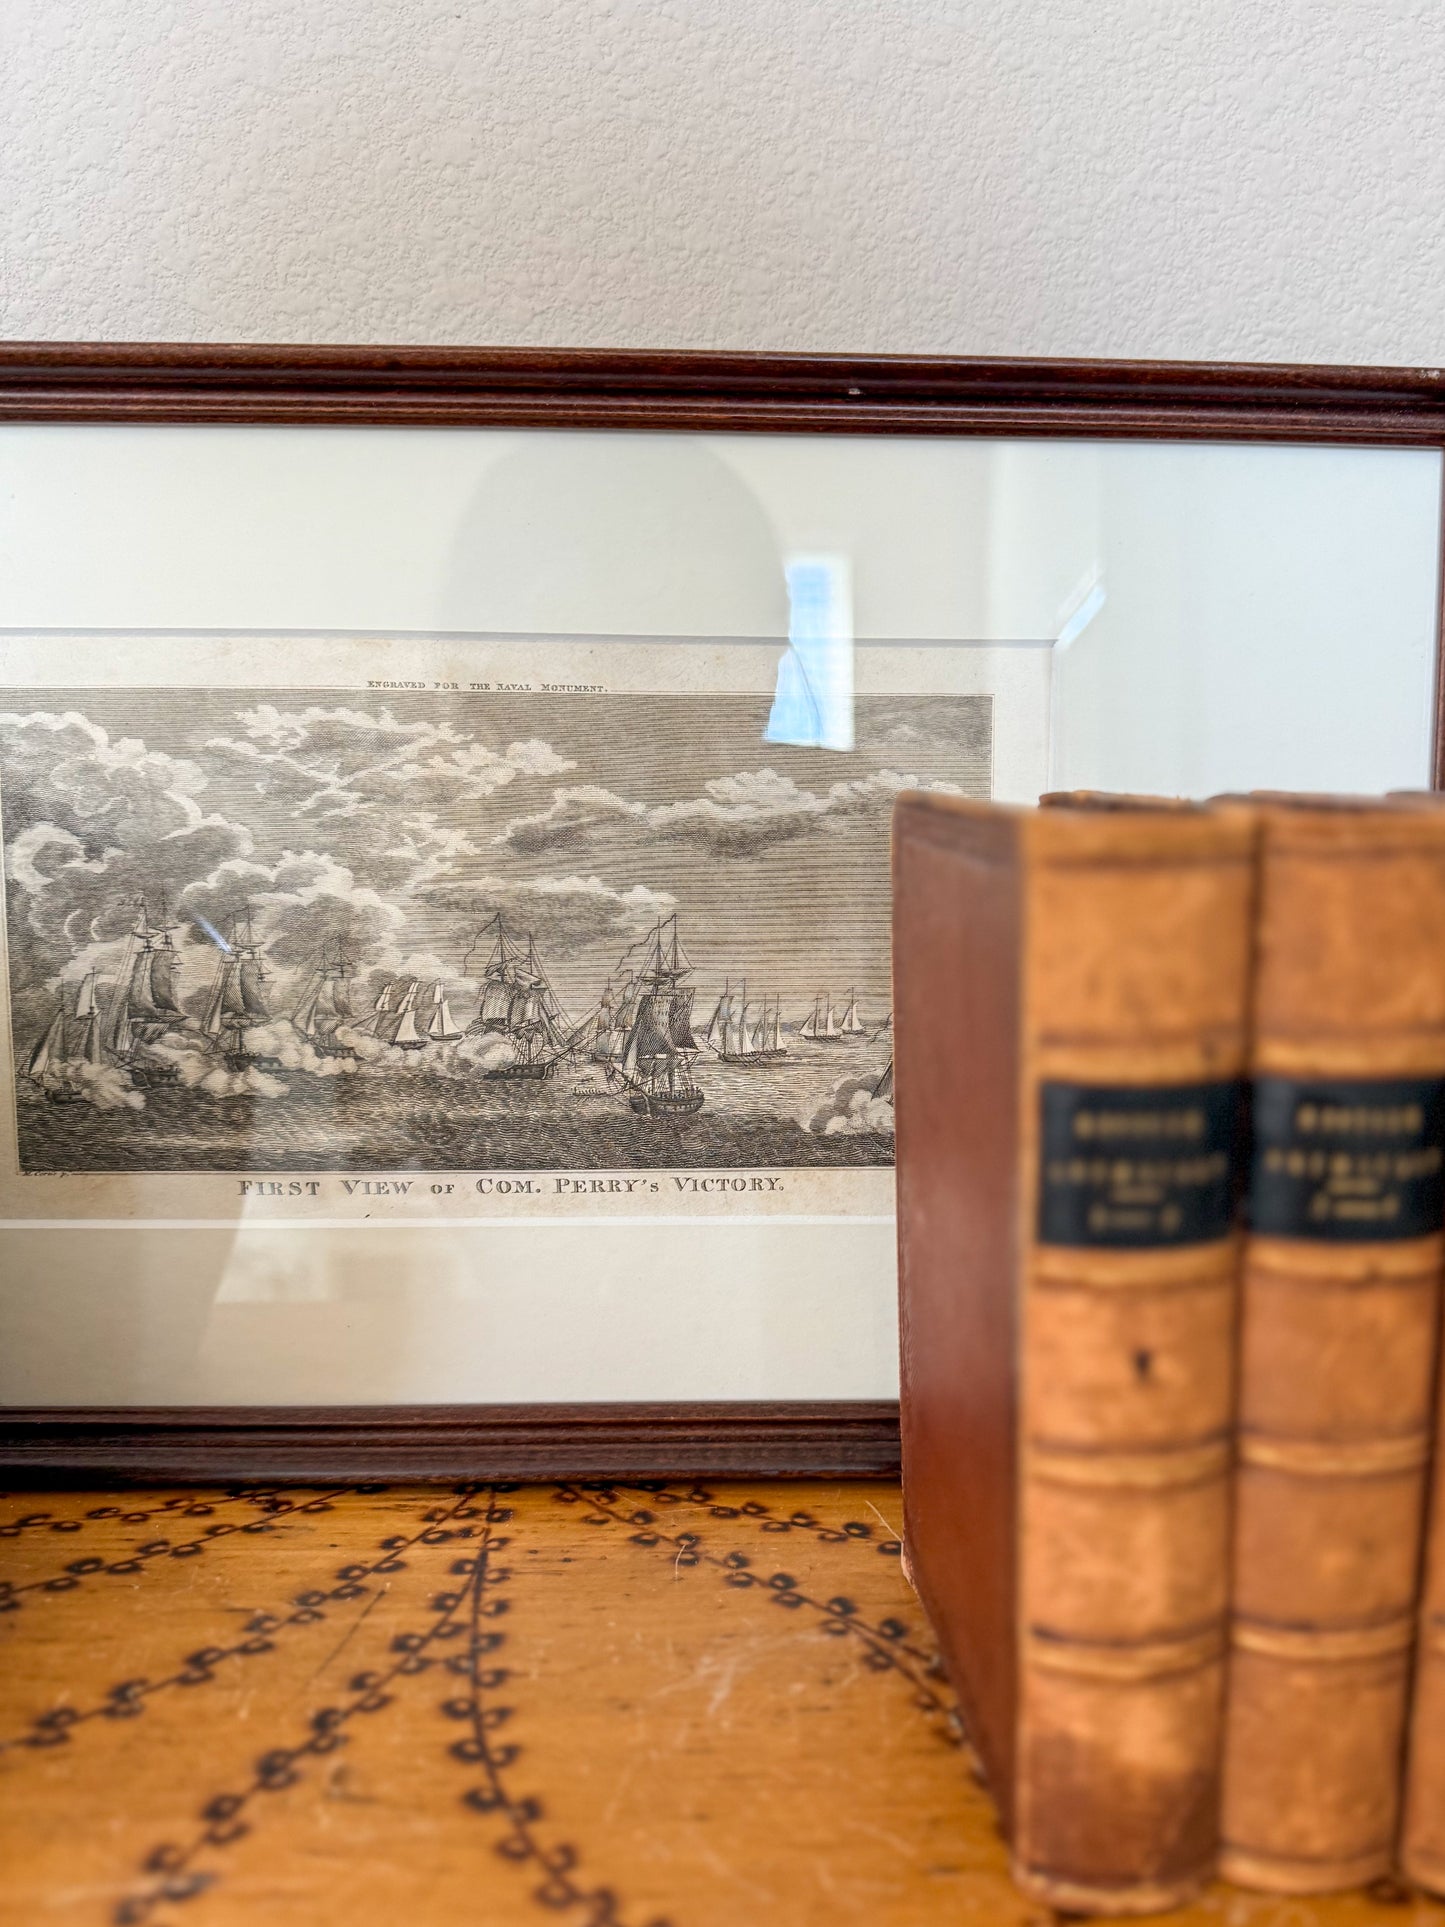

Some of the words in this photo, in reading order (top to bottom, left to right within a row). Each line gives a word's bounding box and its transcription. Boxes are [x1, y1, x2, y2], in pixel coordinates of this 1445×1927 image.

[366, 680, 426, 689] ENGRAVED
[434, 682, 459, 690] FOR
[496, 683, 532, 691] NAVAL
[541, 683, 608, 693] MONUMENT.
[237, 1180, 321, 1196] FIRST
[340, 1179, 414, 1195] VIEW
[430, 1183, 455, 1194] OF
[476, 1178, 541, 1195] COM.
[671, 1176, 785, 1193] VICTORY.
